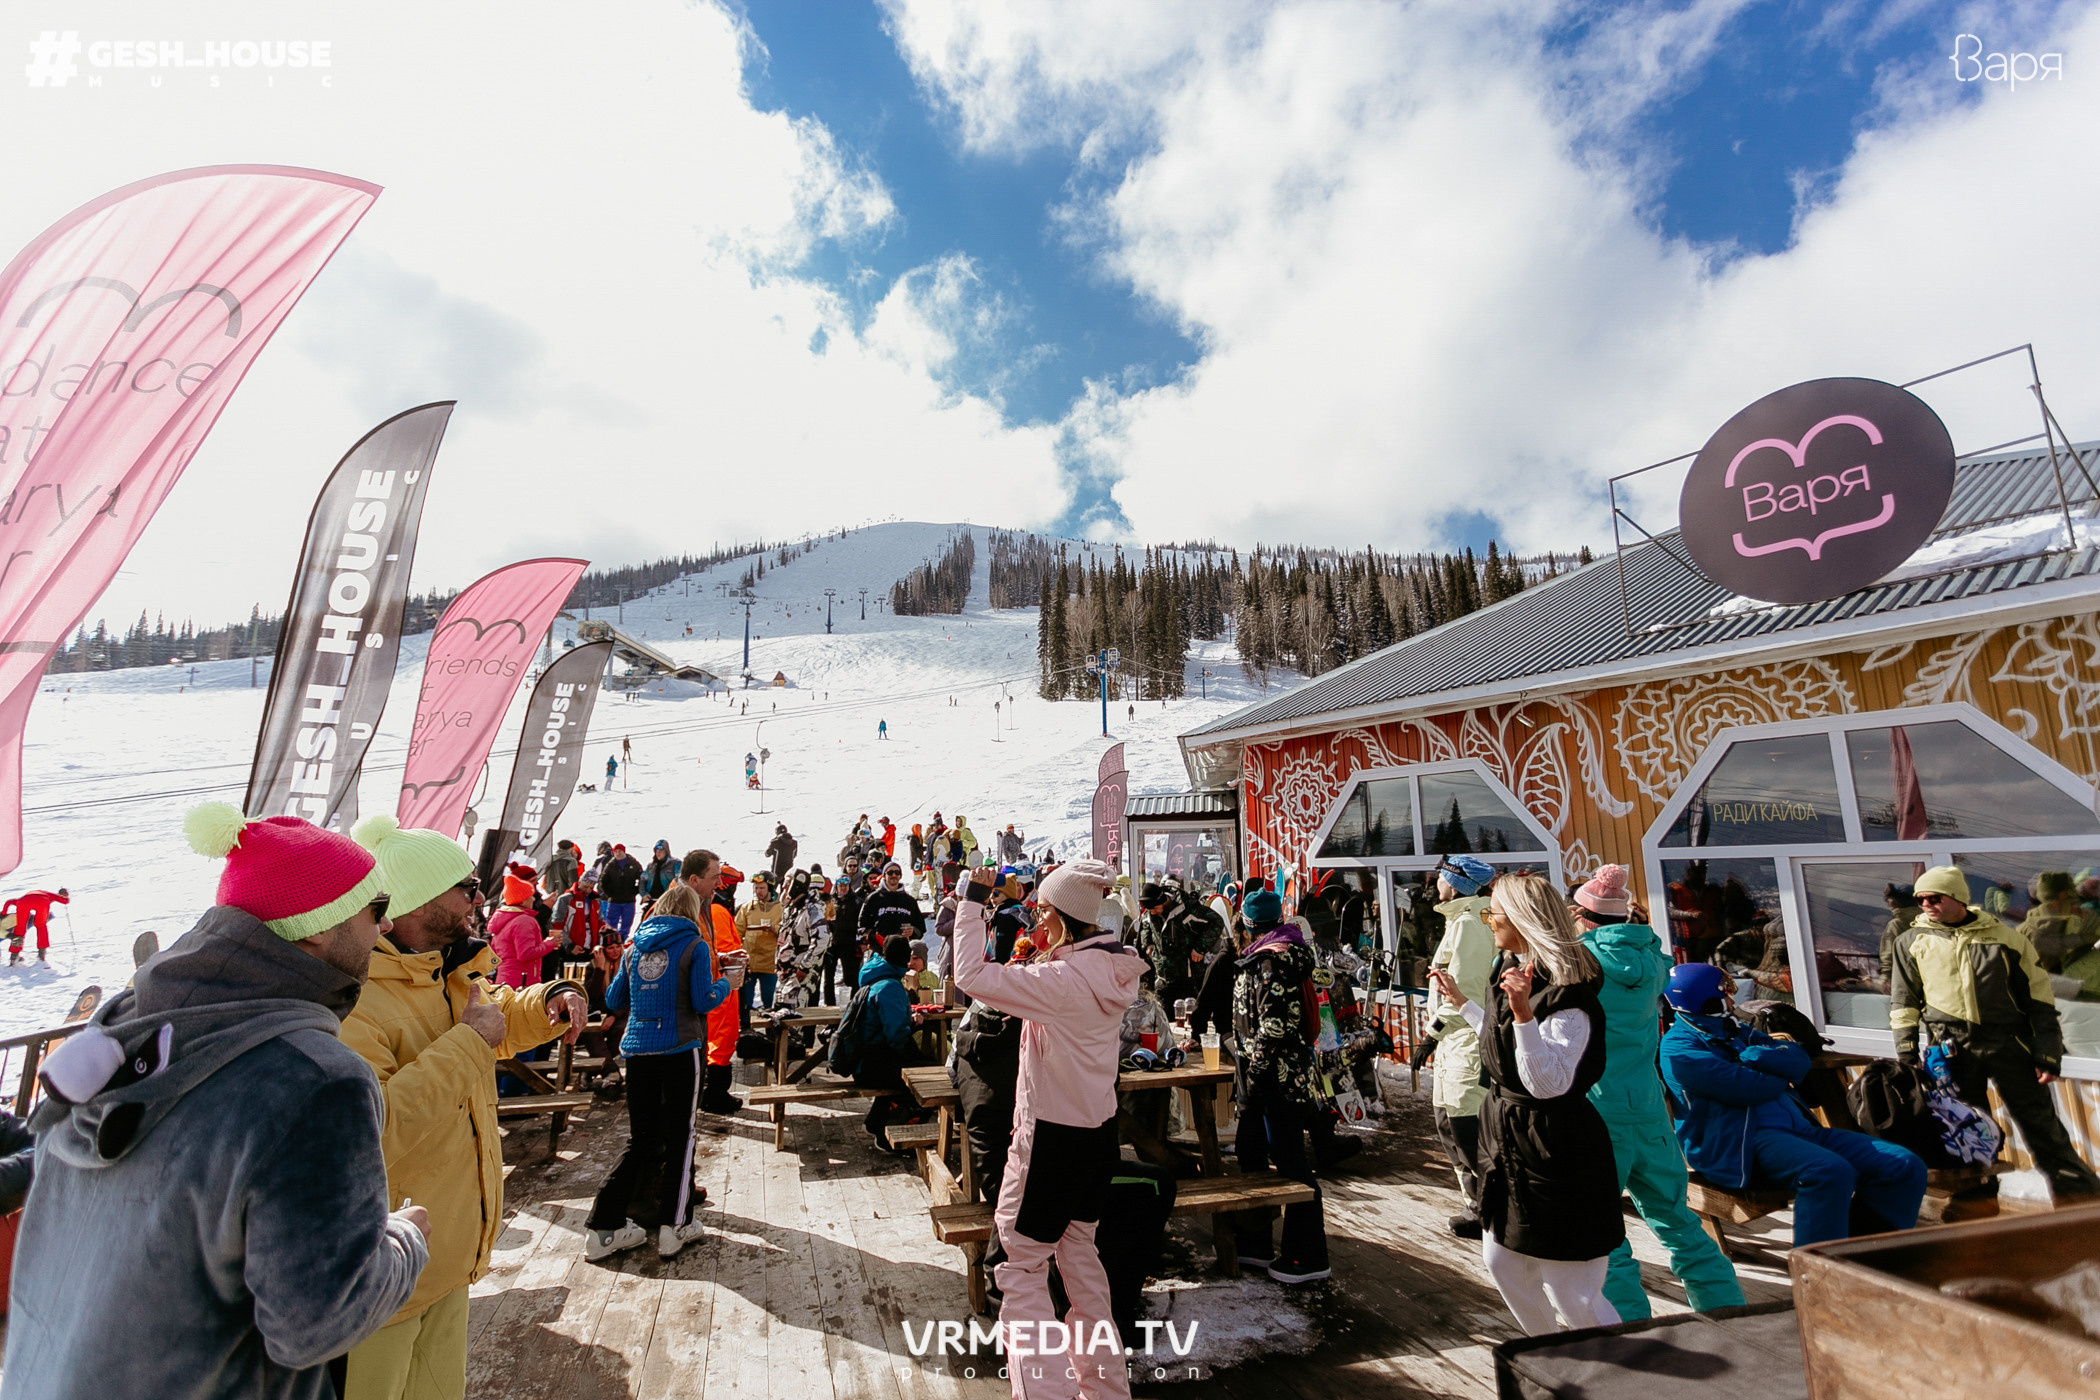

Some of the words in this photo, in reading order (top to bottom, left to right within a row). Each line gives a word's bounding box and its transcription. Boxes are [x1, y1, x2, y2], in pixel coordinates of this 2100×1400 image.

[1, 344, 216, 401] dance
[0, 483, 118, 537] arya
[1742, 464, 1871, 522] Варя
[425, 654, 519, 677] riends
[414, 711, 472, 733] arya
[409, 738, 434, 756] ar
[550, 683, 587, 805] USIC
[1713, 803, 1757, 825] РАДИ
[1760, 800, 1818, 821] КАЙФА
